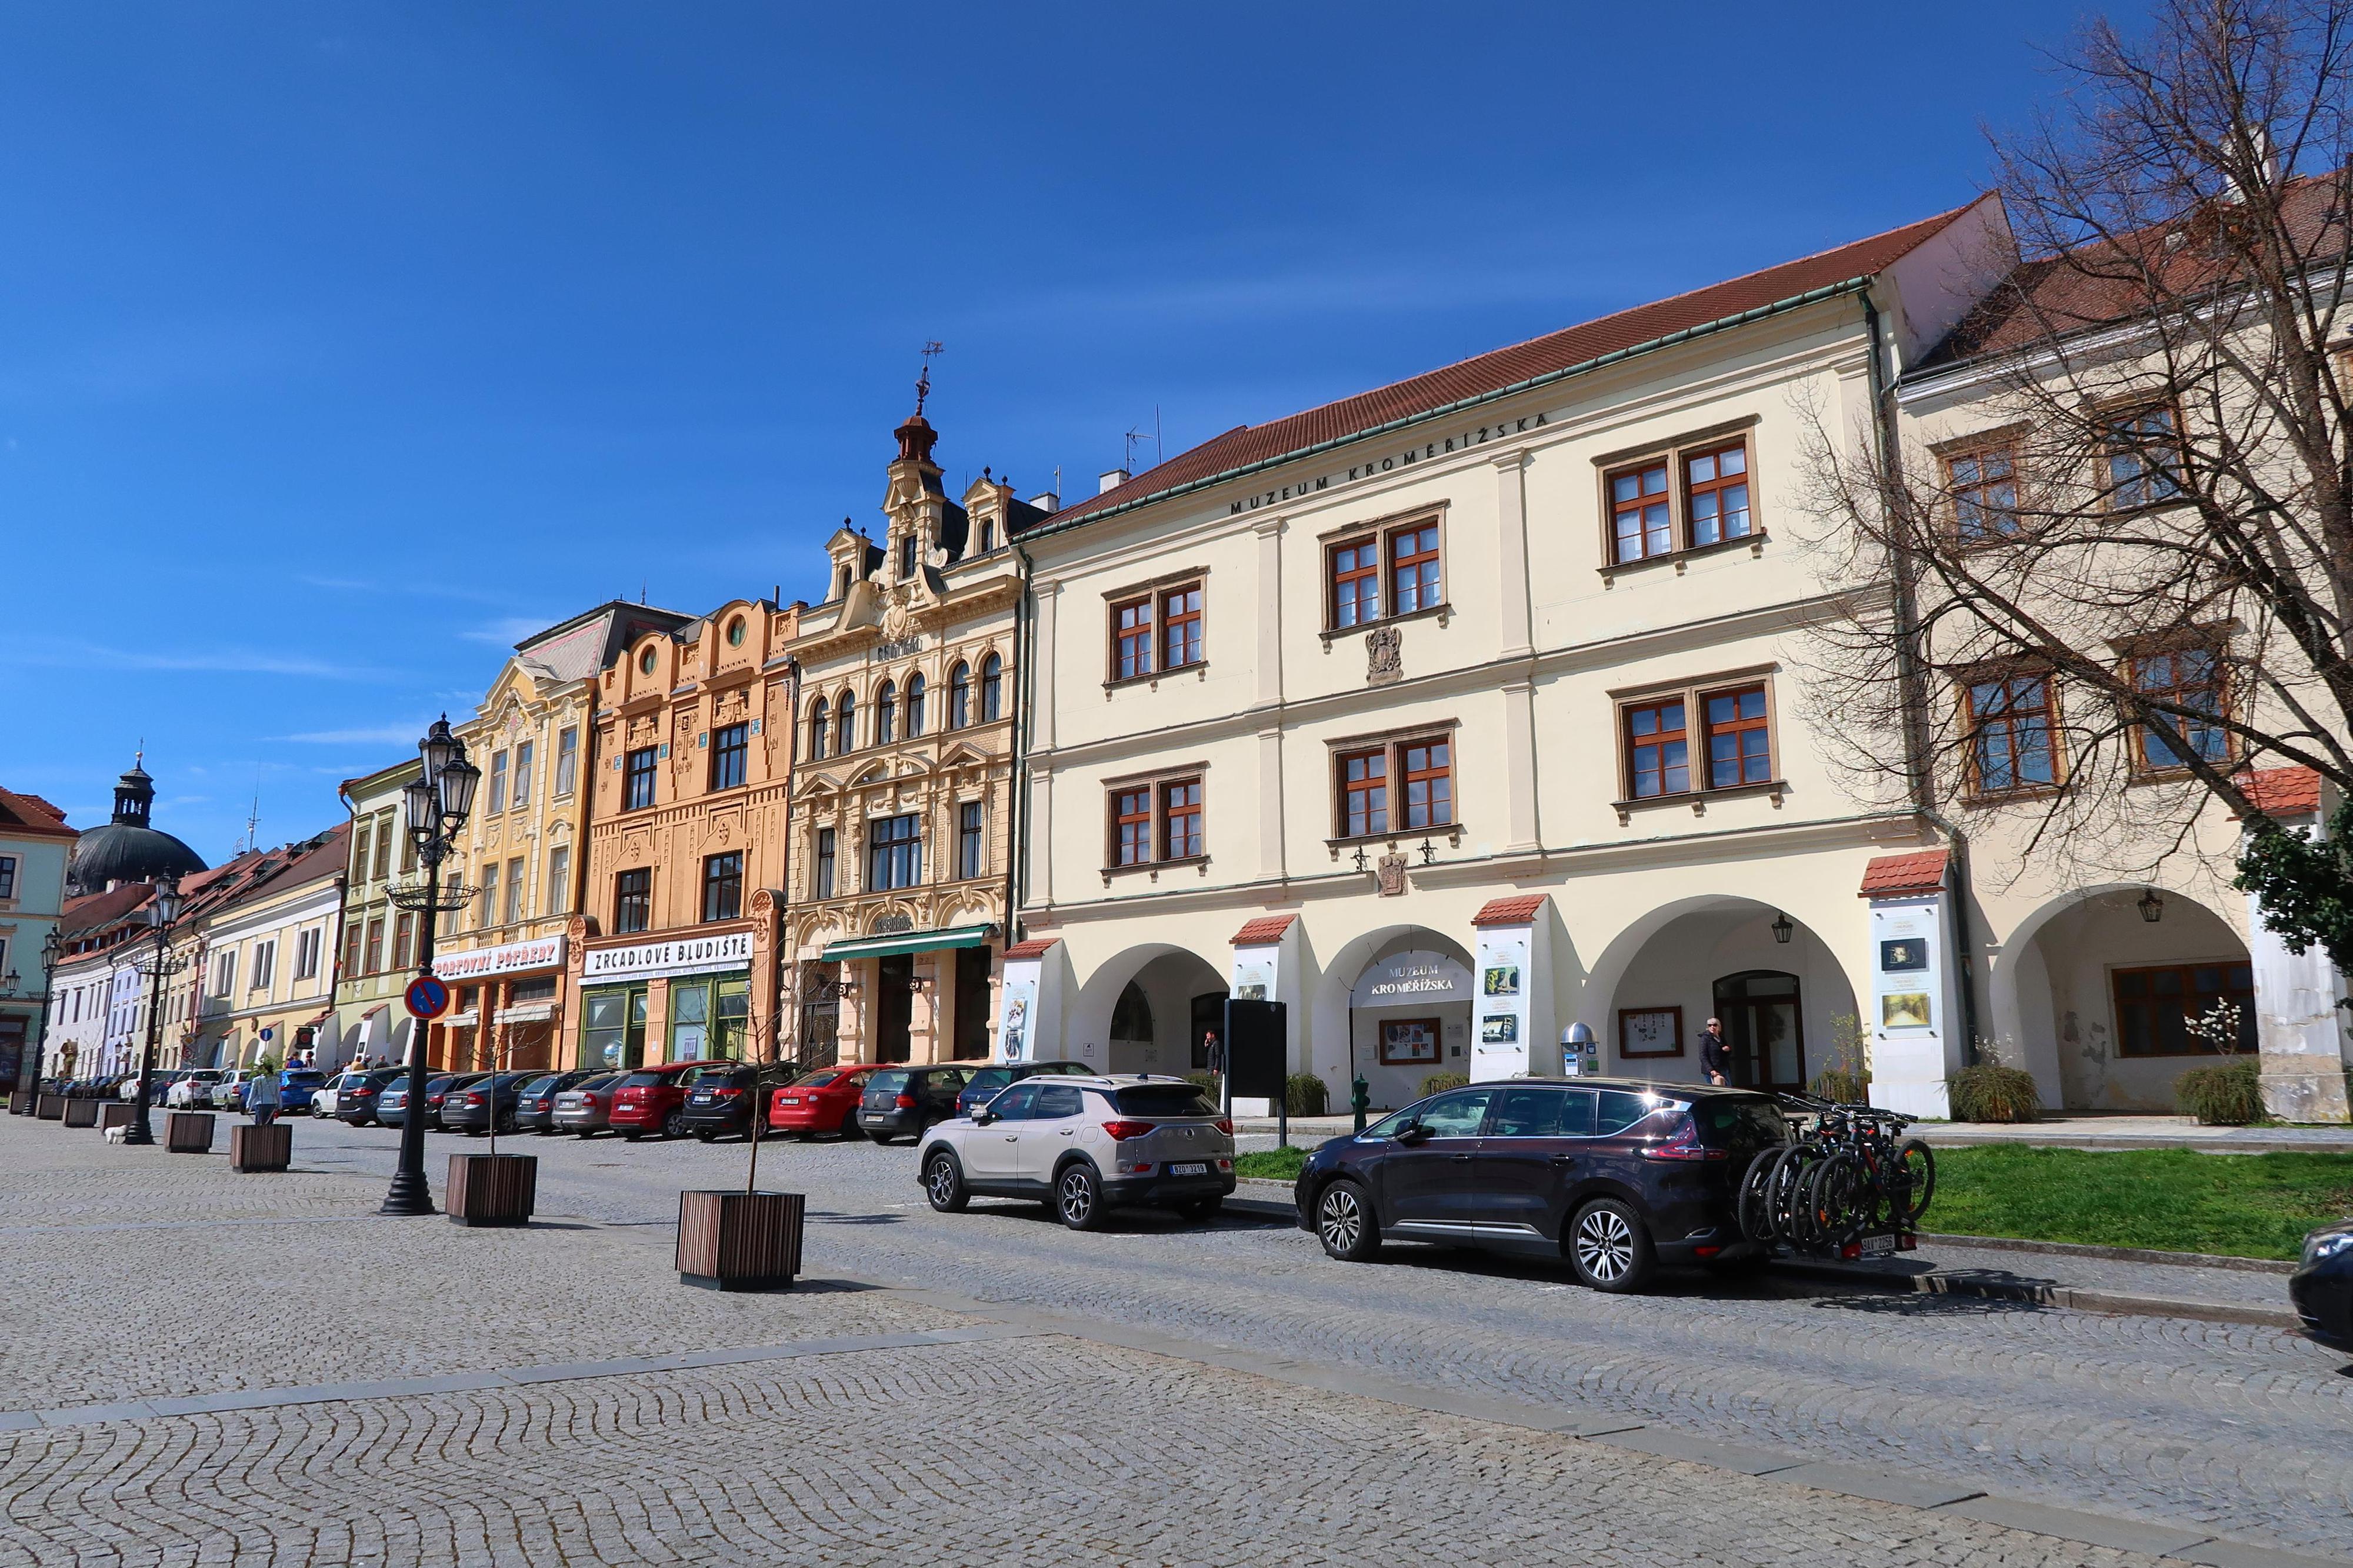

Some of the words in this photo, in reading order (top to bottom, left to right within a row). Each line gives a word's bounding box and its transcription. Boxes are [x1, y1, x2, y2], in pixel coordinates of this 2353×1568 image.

[1230, 476, 1328, 515] MUZEUM
[1348, 412, 1549, 481] KROMĚŘÍŽSKA
[432, 950, 492, 978] PORTOVNÍ
[496, 943, 555, 969] POTŘEBY
[595, 943, 671, 970] ZRCADLOVÉ
[678, 934, 746, 962] BLUDIŠTĚ
[1372, 979, 1454, 995] KROMĚŘÍŽSKA
[1389, 964, 1438, 978] MUZEUM
